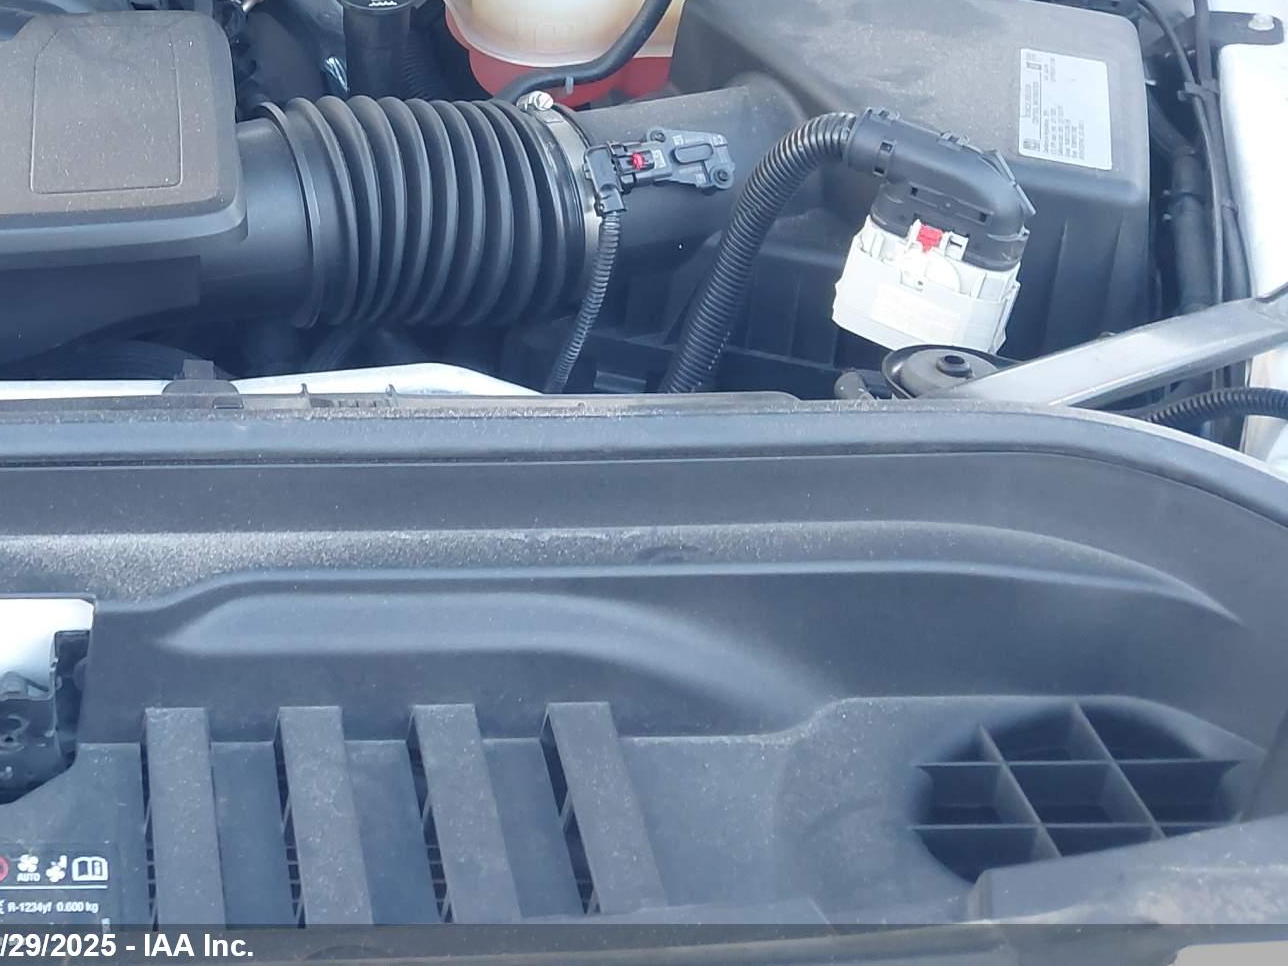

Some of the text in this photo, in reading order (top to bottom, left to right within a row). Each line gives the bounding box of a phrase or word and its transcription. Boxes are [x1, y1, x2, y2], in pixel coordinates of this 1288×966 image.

[17, 872, 40, 882] AUTO
[7, 901, 52, 914] R-1234yf
[85, 901, 99, 913] kg
